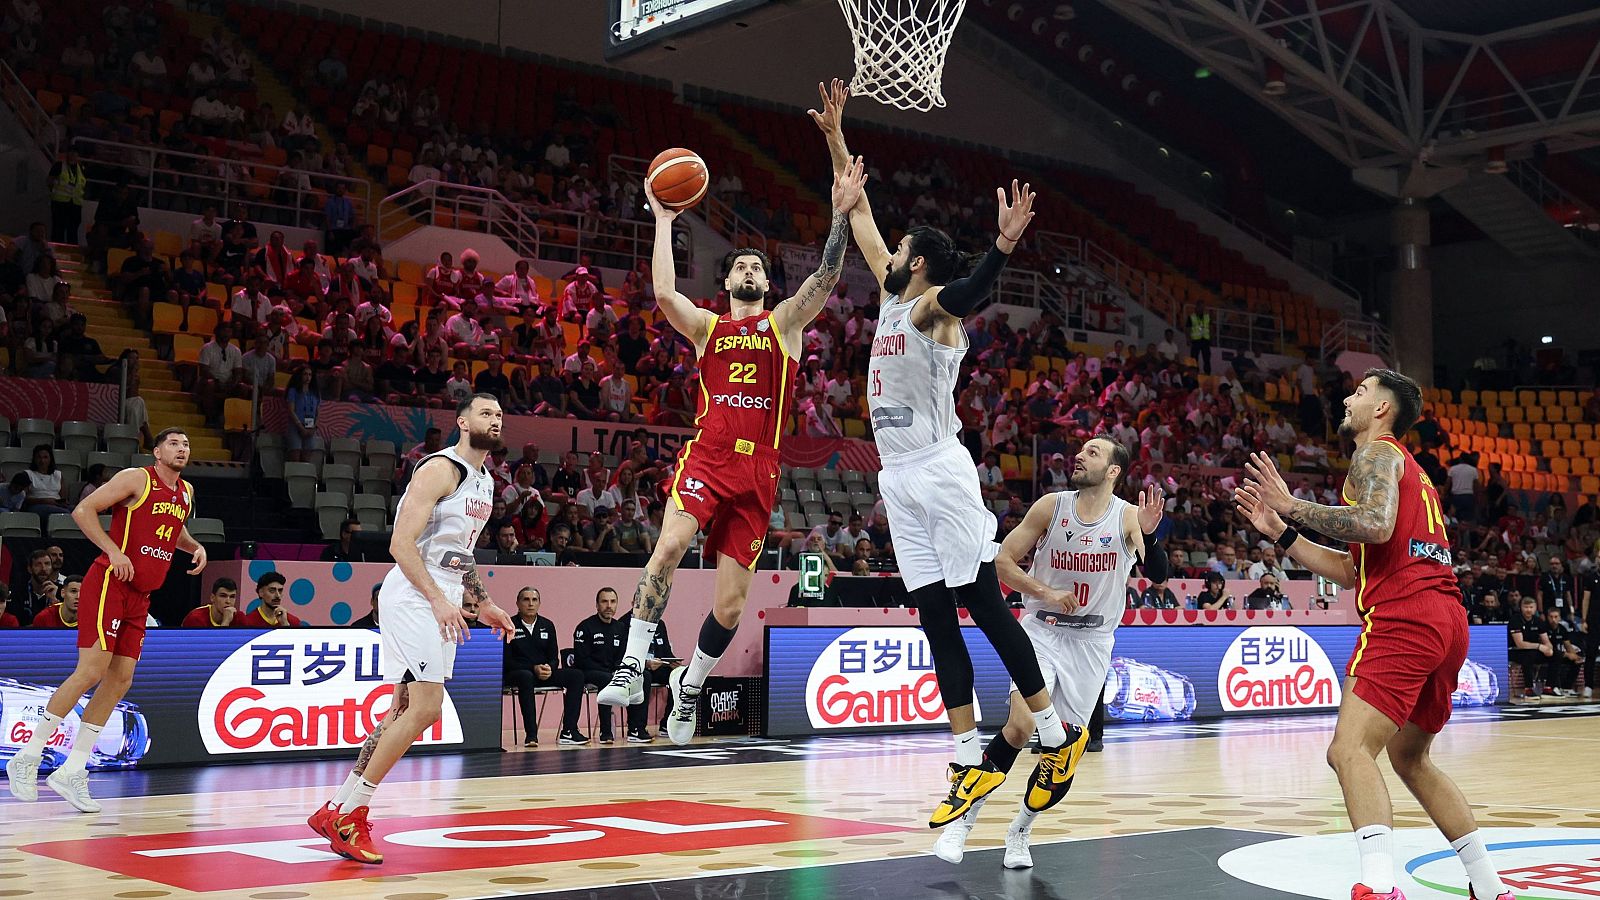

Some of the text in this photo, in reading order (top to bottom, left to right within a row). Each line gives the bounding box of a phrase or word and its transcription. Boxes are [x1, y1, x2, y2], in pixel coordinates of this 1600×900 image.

[714, 332, 772, 354] ESPAÑA
[728, 362, 757, 384] 22
[152, 502, 186, 523] ESPAÑA
[155, 524, 174, 542] 44
[140, 545, 173, 562] endesa
[804, 555, 822, 591] 2
[838, 638, 933, 674] 百岁山
[1240, 635, 1308, 666] 百岁山
[250, 642, 384, 686] 百岁山
[710, 700, 737, 712] YOUR
[711, 690, 739, 703] MAKE
[815, 671, 948, 725] Gante
[711, 710, 740, 722] MARK
[131, 815, 788, 865] TCL
